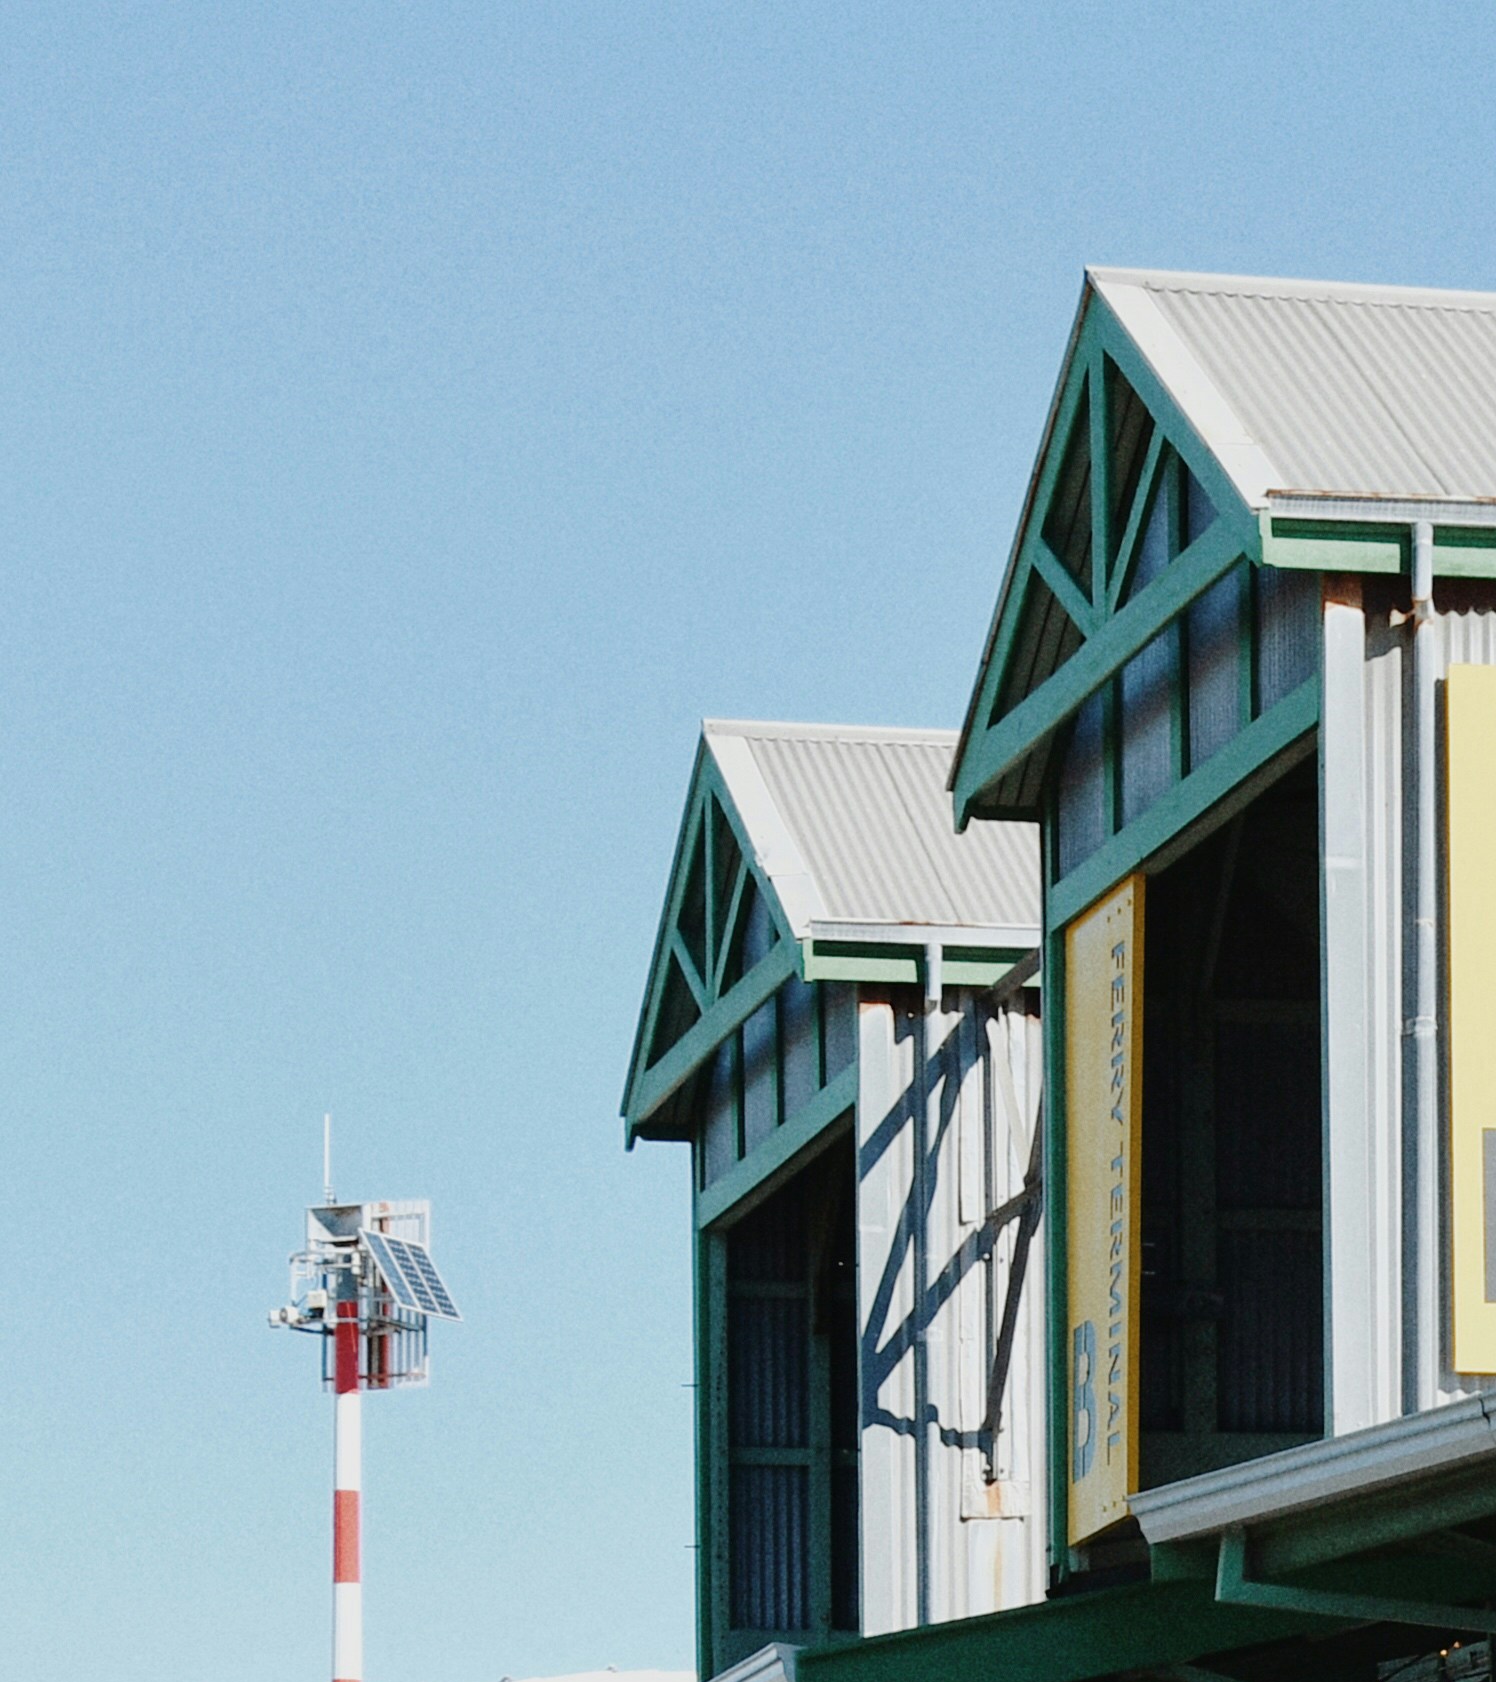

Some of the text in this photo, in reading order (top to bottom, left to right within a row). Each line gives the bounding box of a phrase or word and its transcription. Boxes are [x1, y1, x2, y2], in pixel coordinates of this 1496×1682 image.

[1107, 939, 1126, 1467] FERRY TERMINAL
[1072, 1318, 1096, 1485] B
